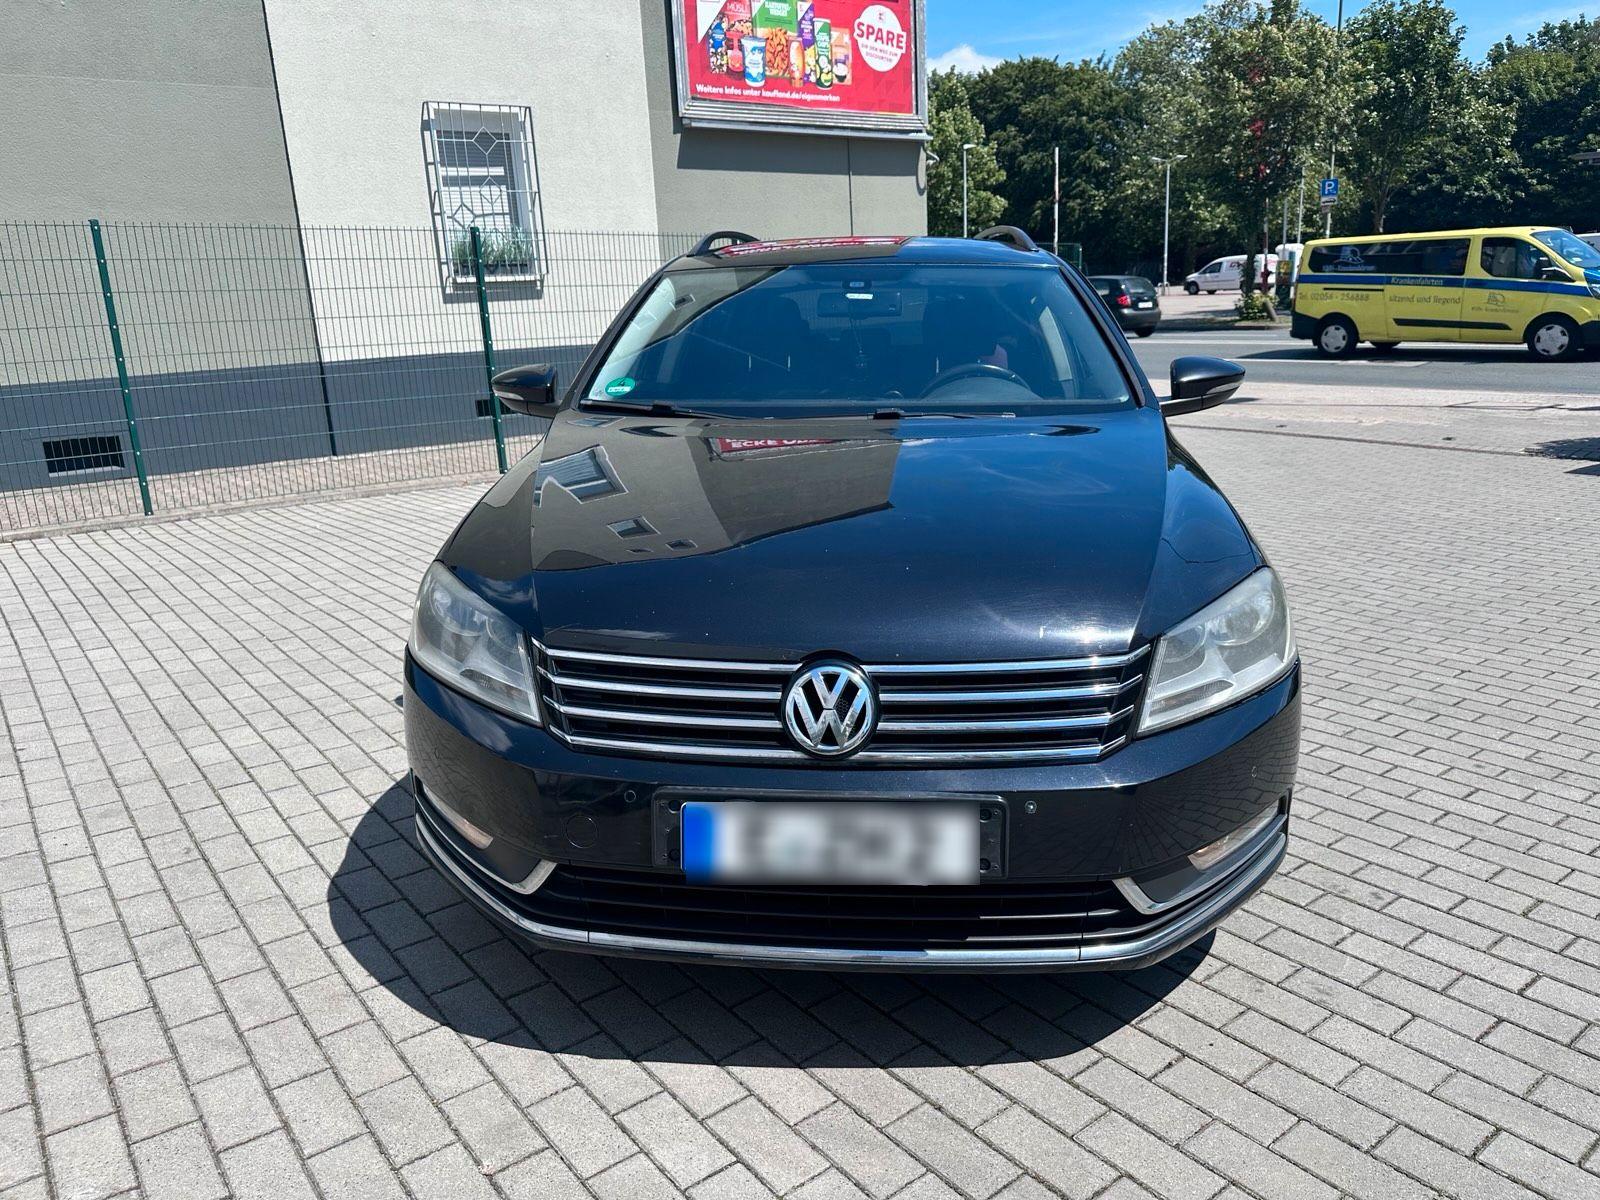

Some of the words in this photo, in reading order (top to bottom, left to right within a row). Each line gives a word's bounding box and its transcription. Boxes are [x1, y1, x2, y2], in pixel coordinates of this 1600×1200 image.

[857, 21, 904, 50] SPARE
[696, 84, 723, 94] Weitere
[725, 85, 742, 95] Infos
[743, 88, 761, 96] unter
[762, 89, 840, 102] kaufland.de/eigenmarken
[1325, 181, 1335, 194] P
[1391, 277, 1443, 286] Krankenfahrten
[1389, 294, 1415, 303] sitzend
[1417, 295, 1431, 303] und
[1433, 295, 1461, 306] liegend
